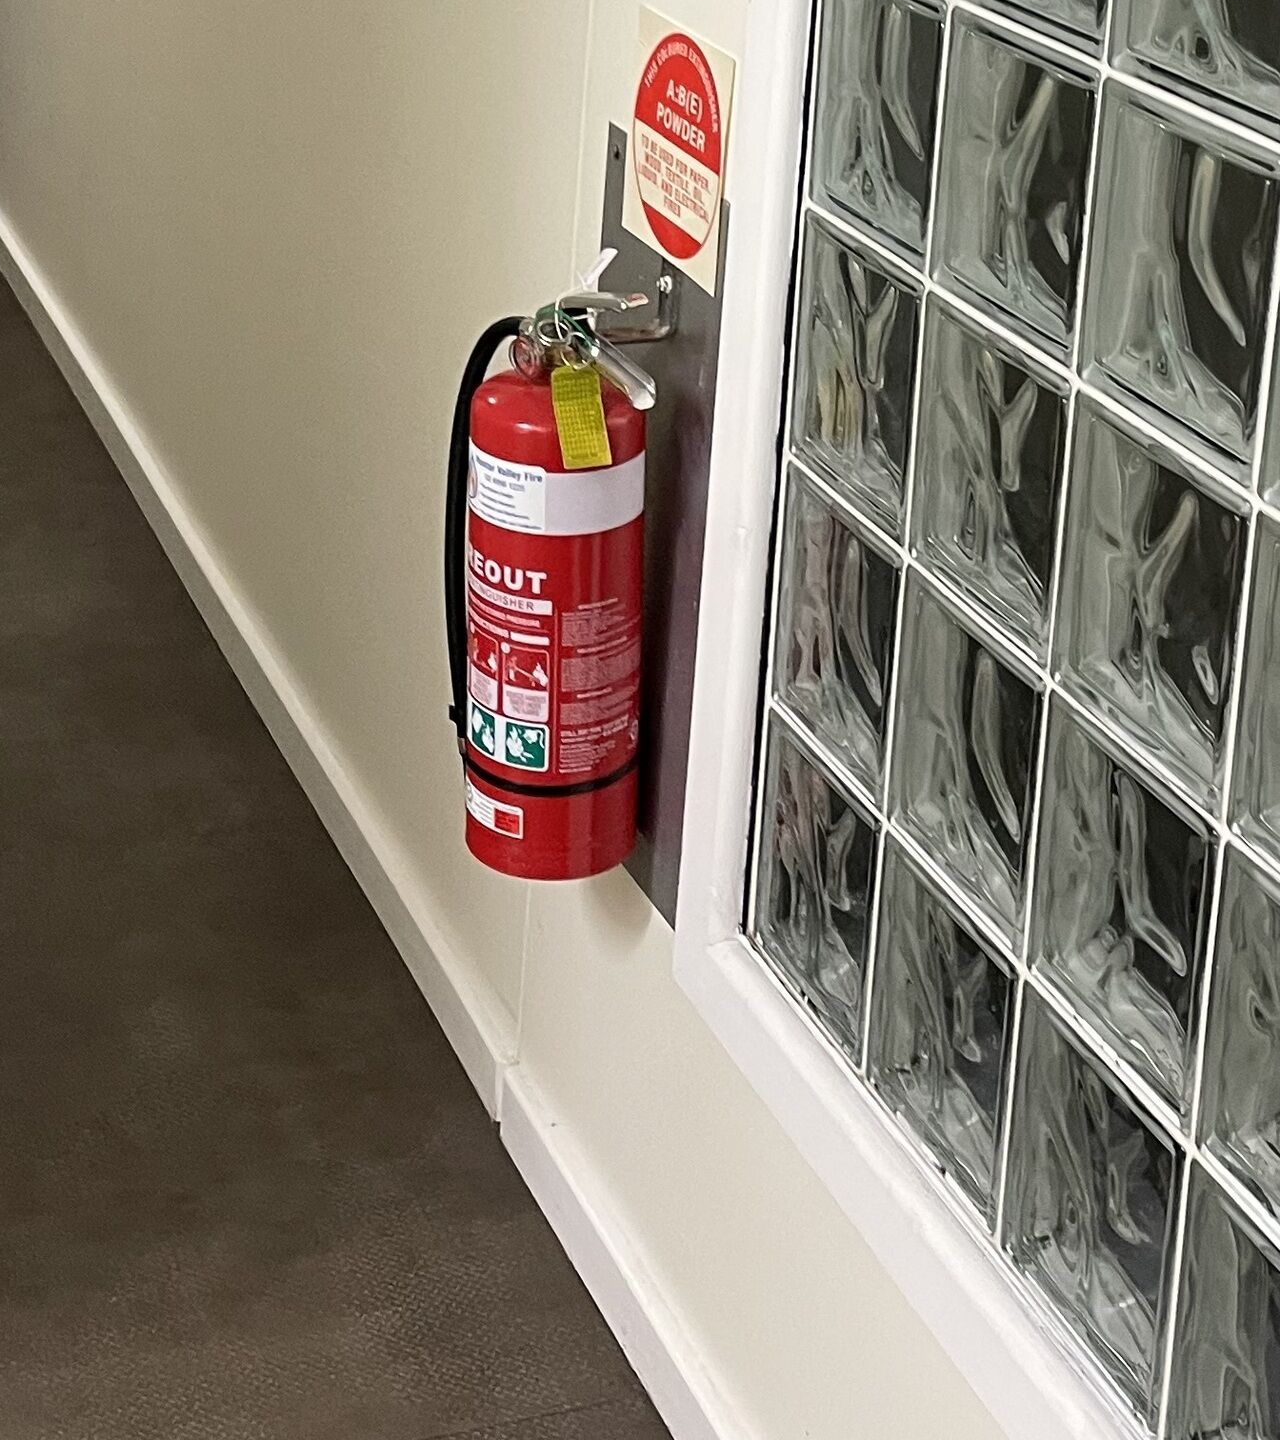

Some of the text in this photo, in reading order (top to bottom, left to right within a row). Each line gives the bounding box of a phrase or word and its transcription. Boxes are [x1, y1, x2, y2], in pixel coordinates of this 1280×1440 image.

[666, 79, 703, 124] A:B(E)
[656, 101, 706, 154] POWDER
[675, 157, 688, 178] FOR
[524, 472, 543, 483] Fire
